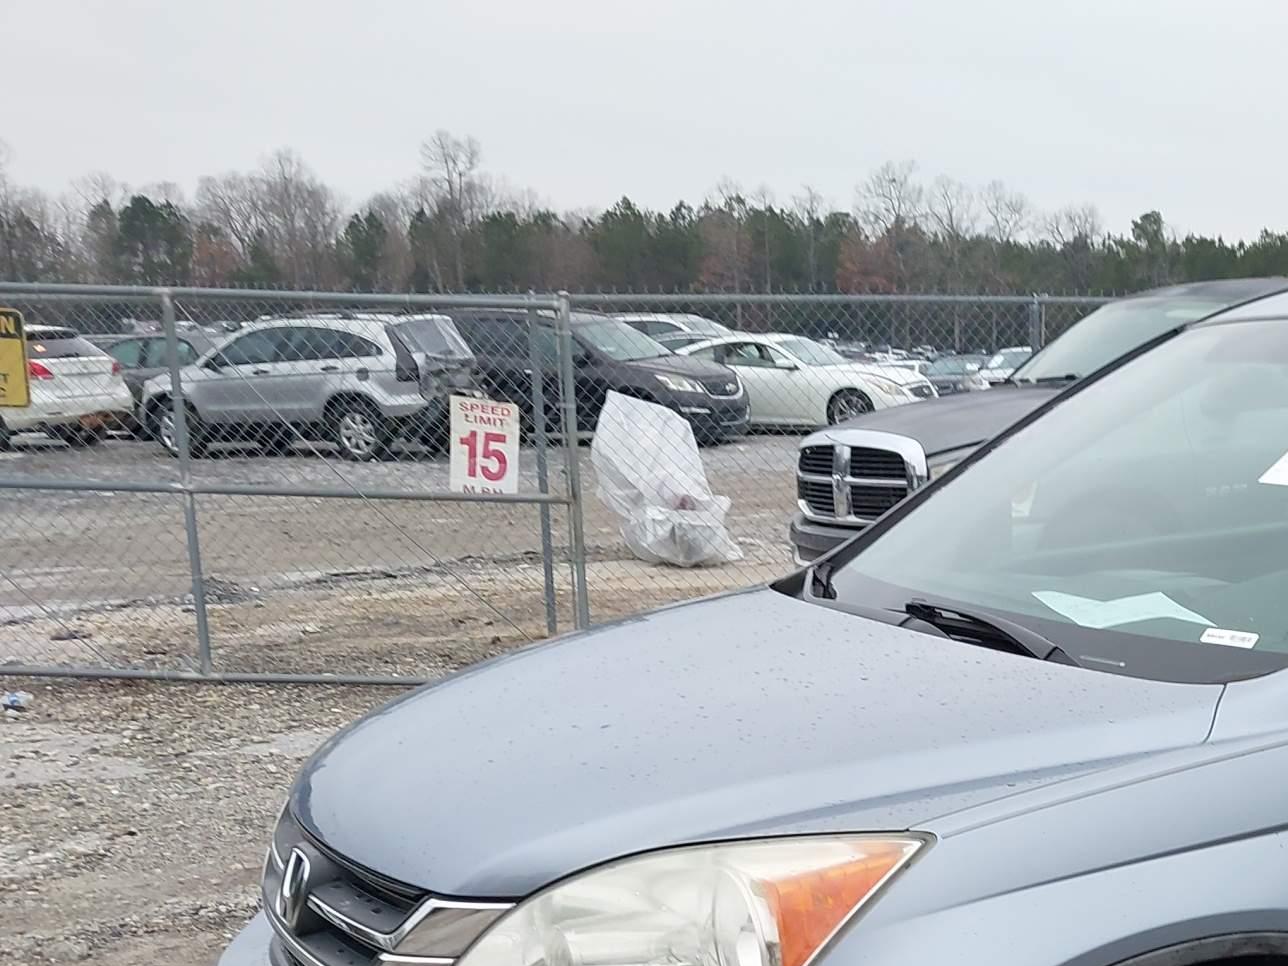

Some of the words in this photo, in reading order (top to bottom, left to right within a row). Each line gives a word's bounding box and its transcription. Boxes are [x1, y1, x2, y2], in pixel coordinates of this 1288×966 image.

[459, 401, 512, 417] SPEED
[464, 413, 506, 428] LIMIT
[460, 430, 508, 481] 15
